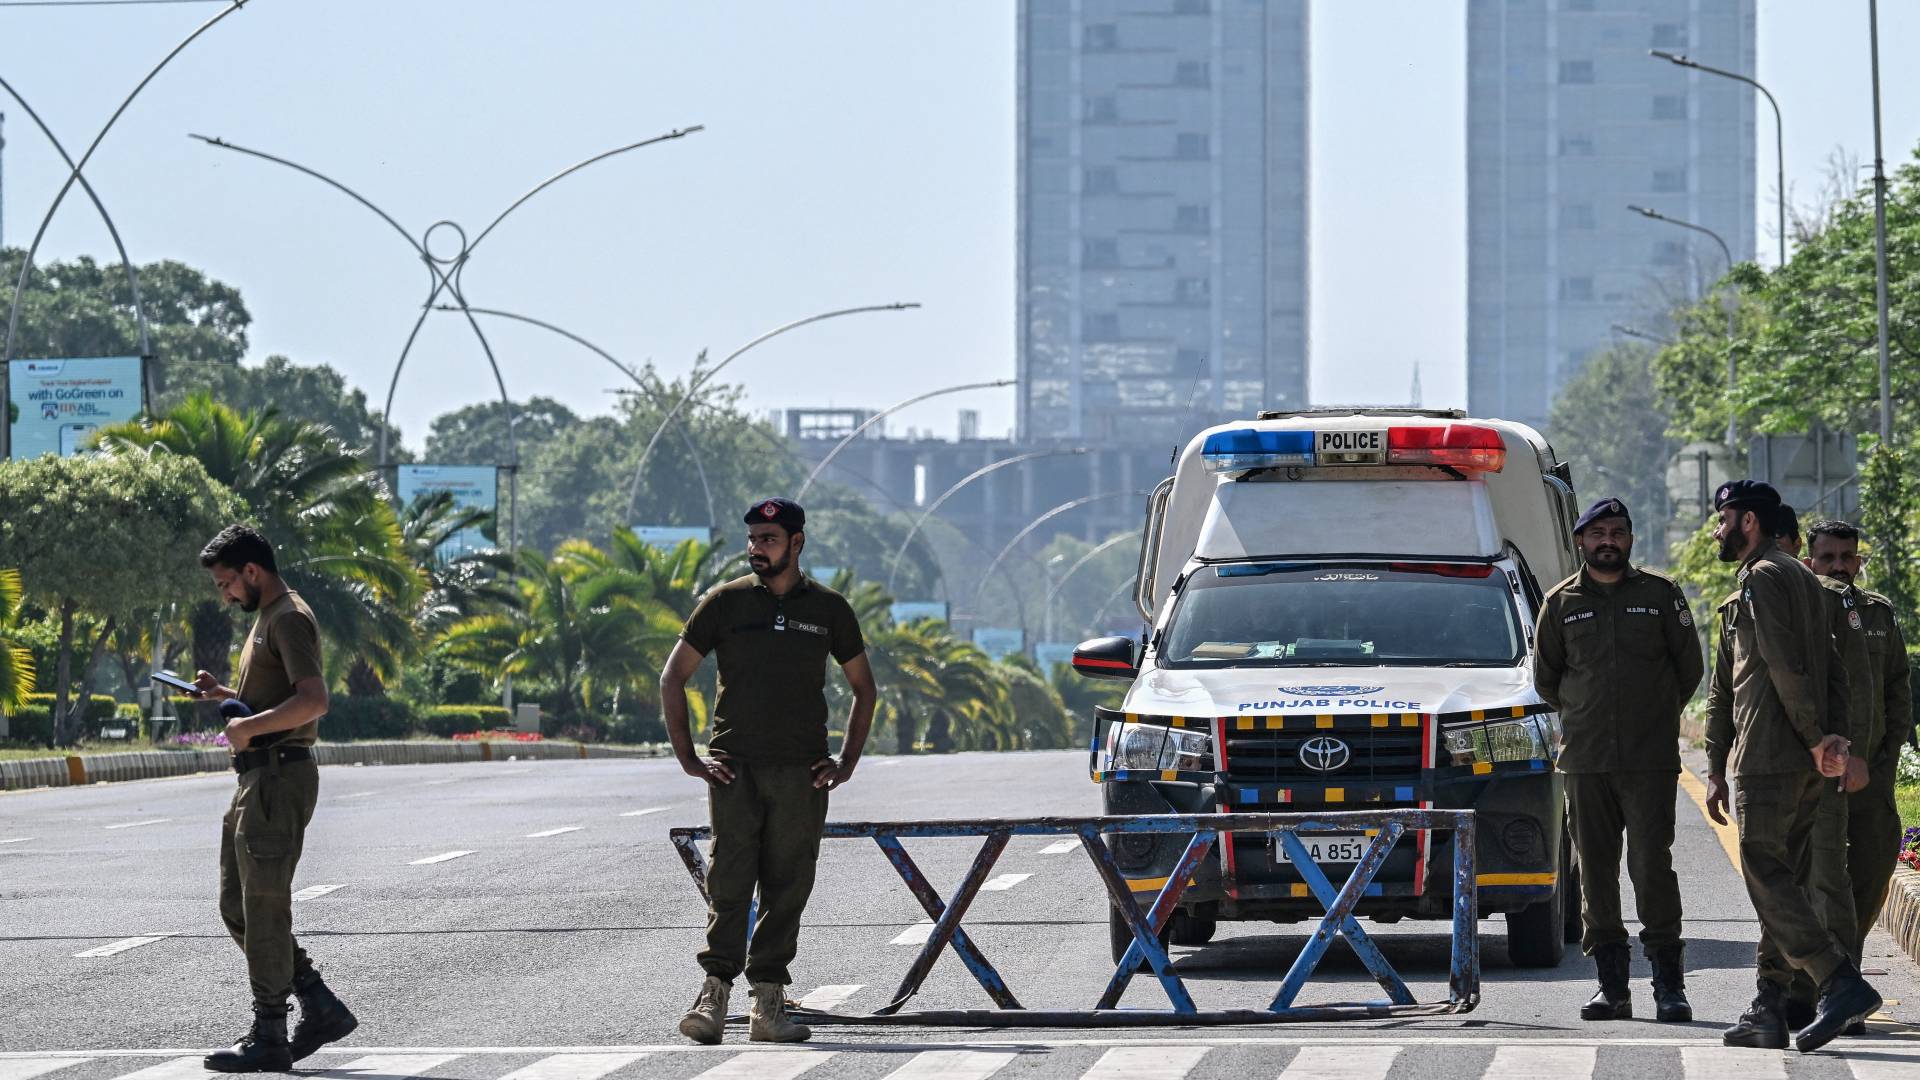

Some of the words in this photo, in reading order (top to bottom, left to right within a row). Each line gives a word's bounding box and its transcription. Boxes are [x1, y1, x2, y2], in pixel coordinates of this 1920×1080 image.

[28, 388, 53, 401] with
[55, 388, 106, 401] GoGreen
[108, 388, 124, 399] on
[1322, 432, 1379, 450] POLICE
[799, 623, 818, 633] POLICE
[1238, 699, 1331, 711] PUNJAB
[1338, 699, 1421, 710] POLICE
[1327, 843, 1362, 860] 851
